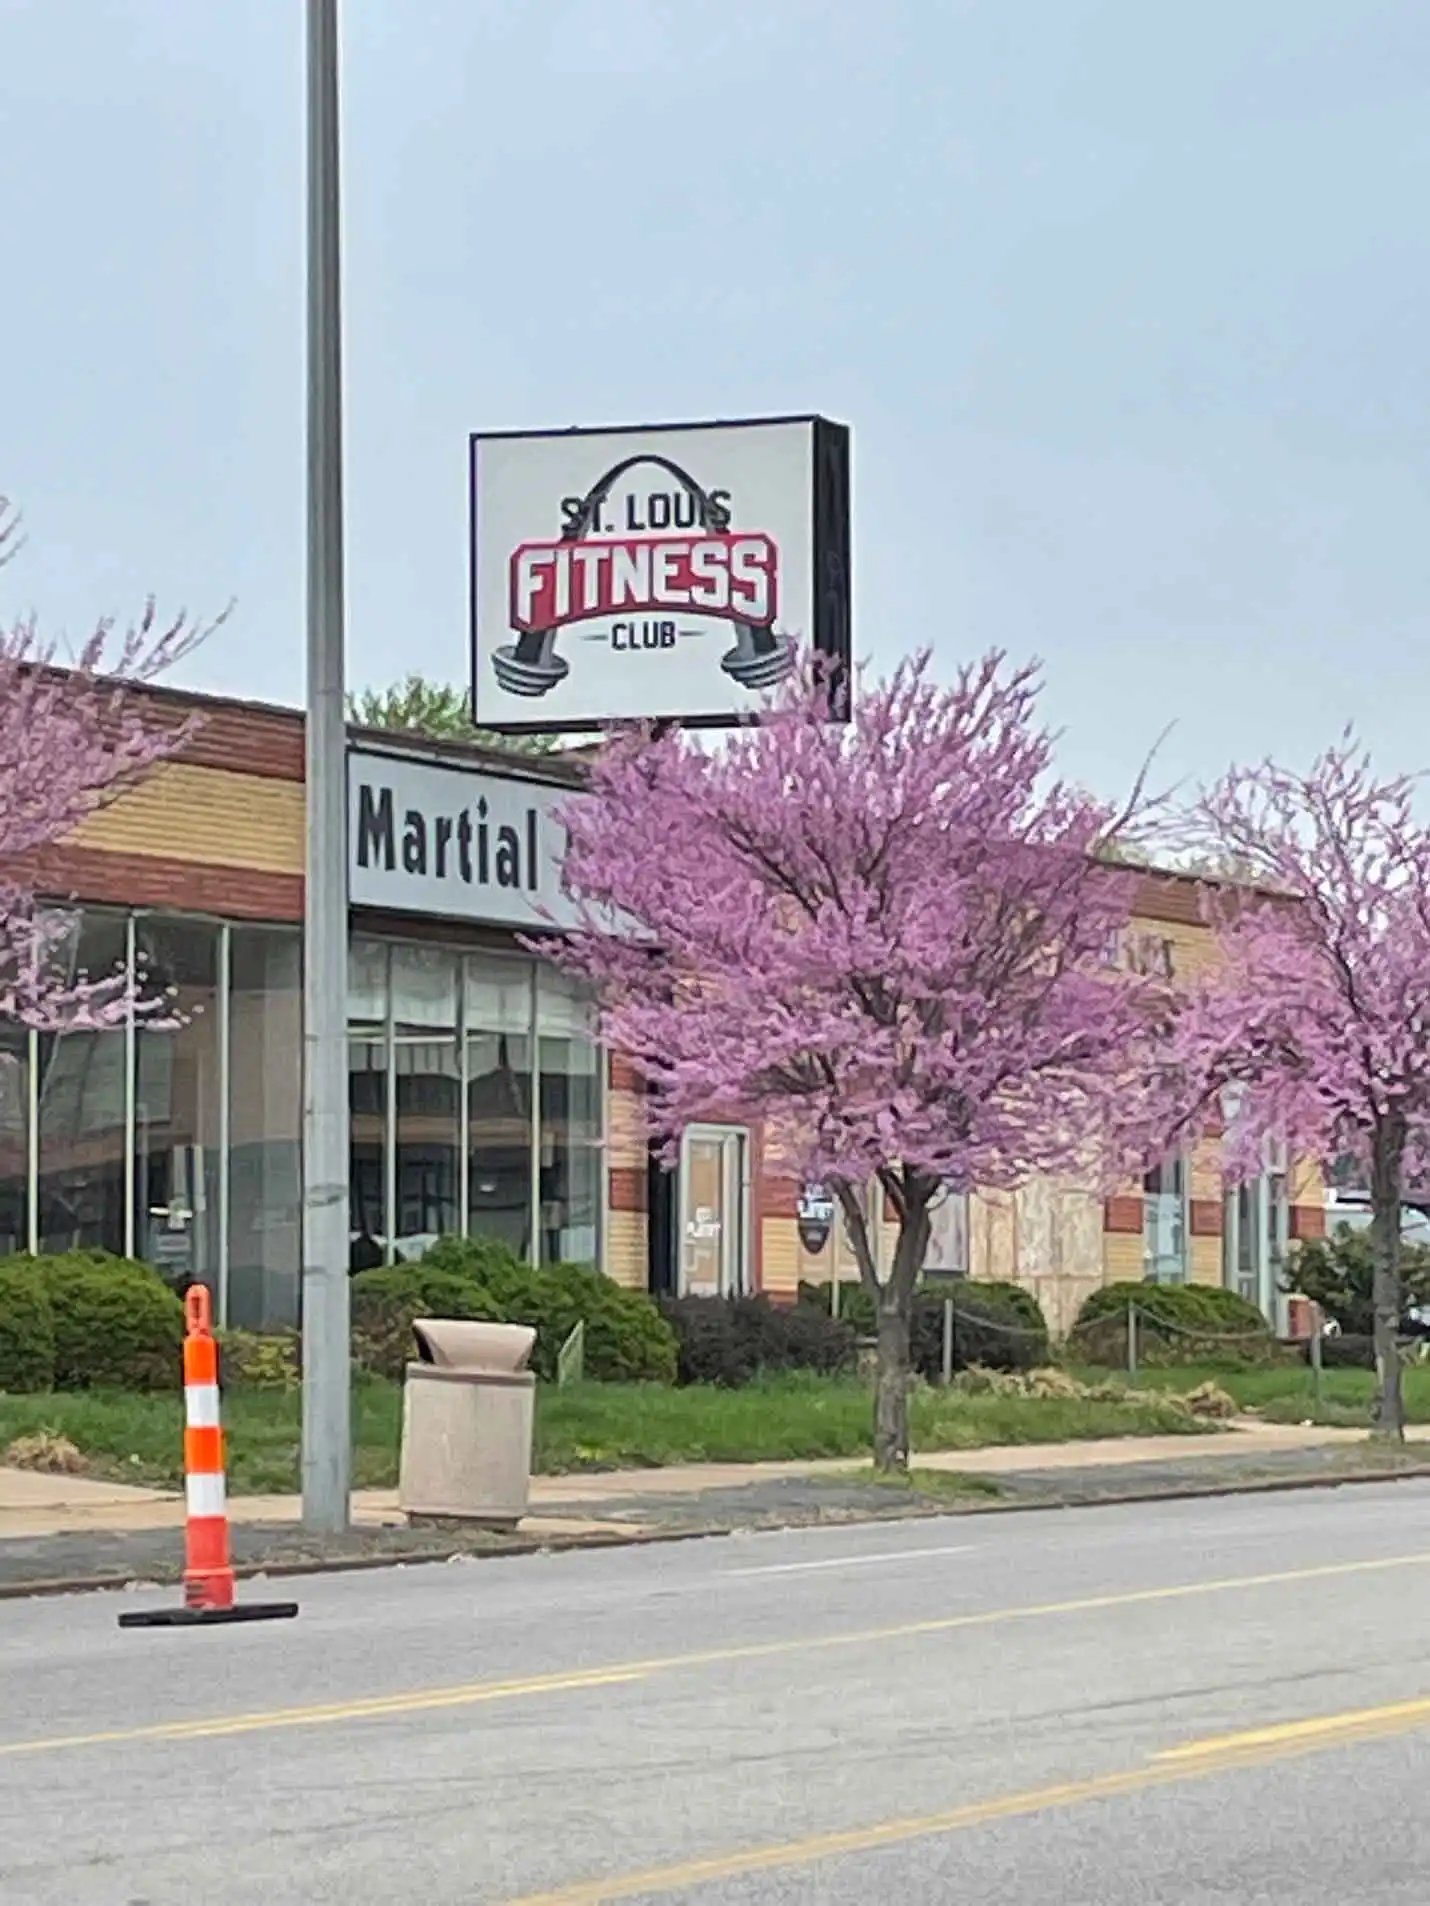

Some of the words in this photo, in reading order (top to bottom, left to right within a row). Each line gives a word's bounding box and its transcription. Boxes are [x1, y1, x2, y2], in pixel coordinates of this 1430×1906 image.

[560, 494, 615, 534] ST.
[626, 489, 732, 531] LOUIS
[516, 539, 770, 625] FITNESS
[611, 621, 676, 650] CLUB
[357, 784, 537, 891] Martial
